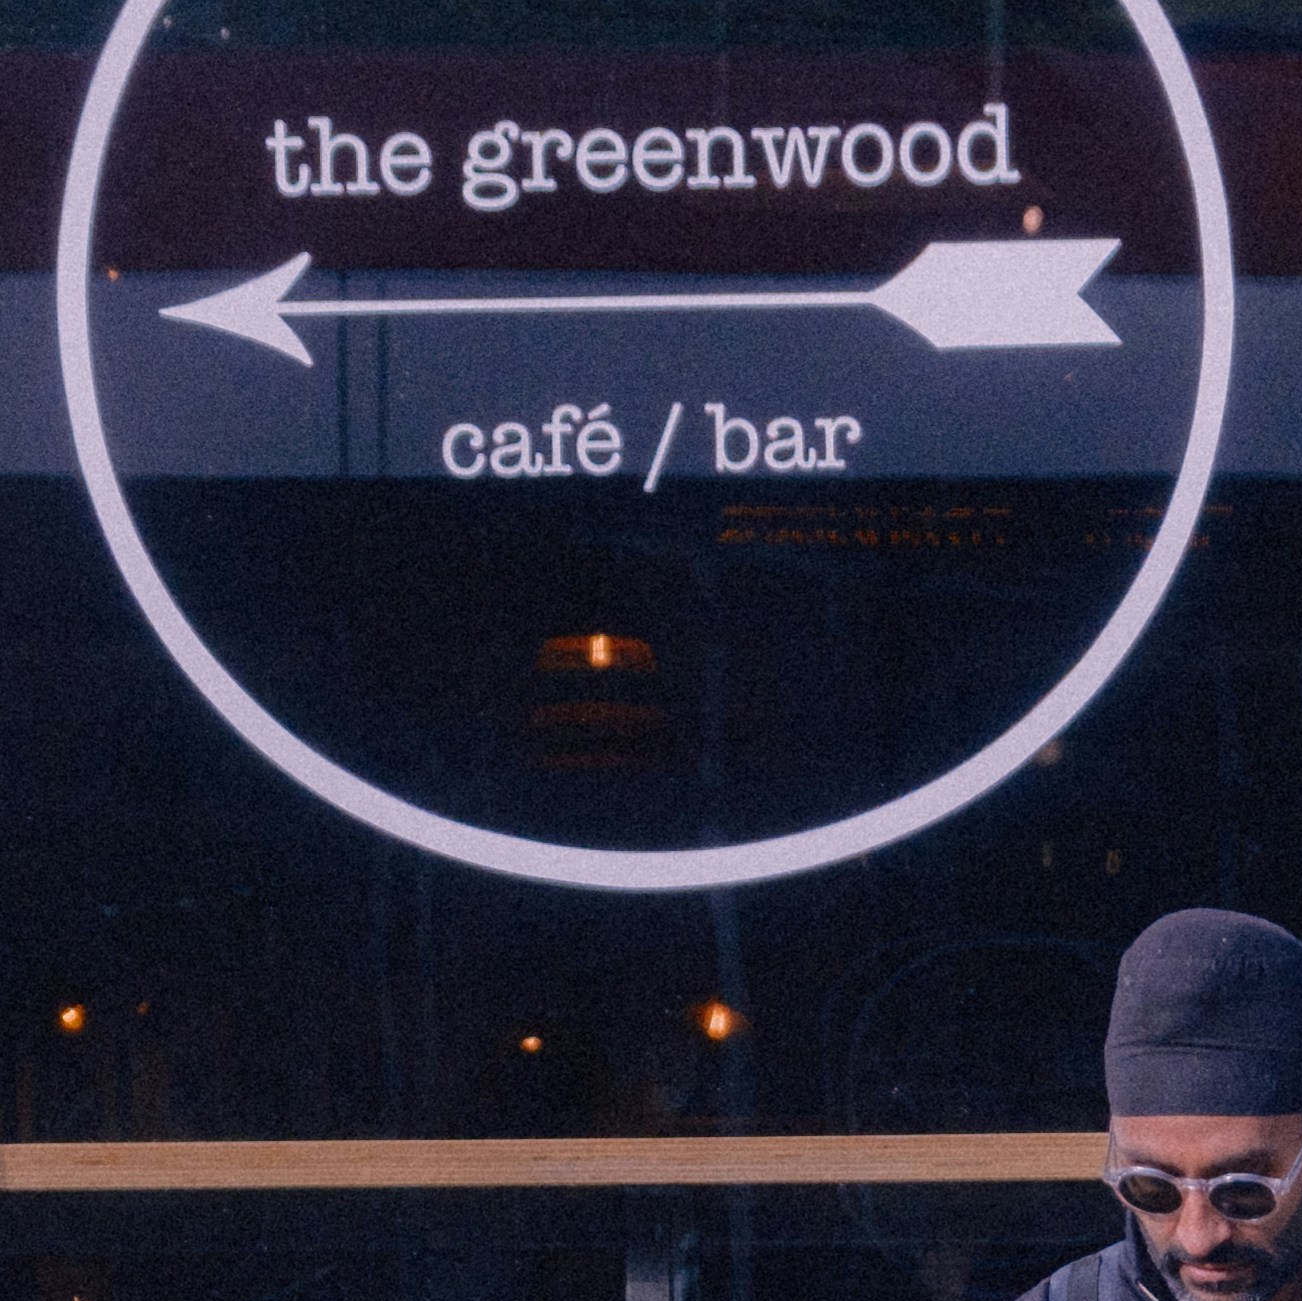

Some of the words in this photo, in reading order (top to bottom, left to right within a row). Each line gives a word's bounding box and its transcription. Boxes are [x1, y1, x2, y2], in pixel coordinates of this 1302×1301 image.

[266, 117, 432, 196] the
[462, 103, 1020, 210] greenwood
[442, 403, 622, 477] café
[704, 403, 862, 472] bar
